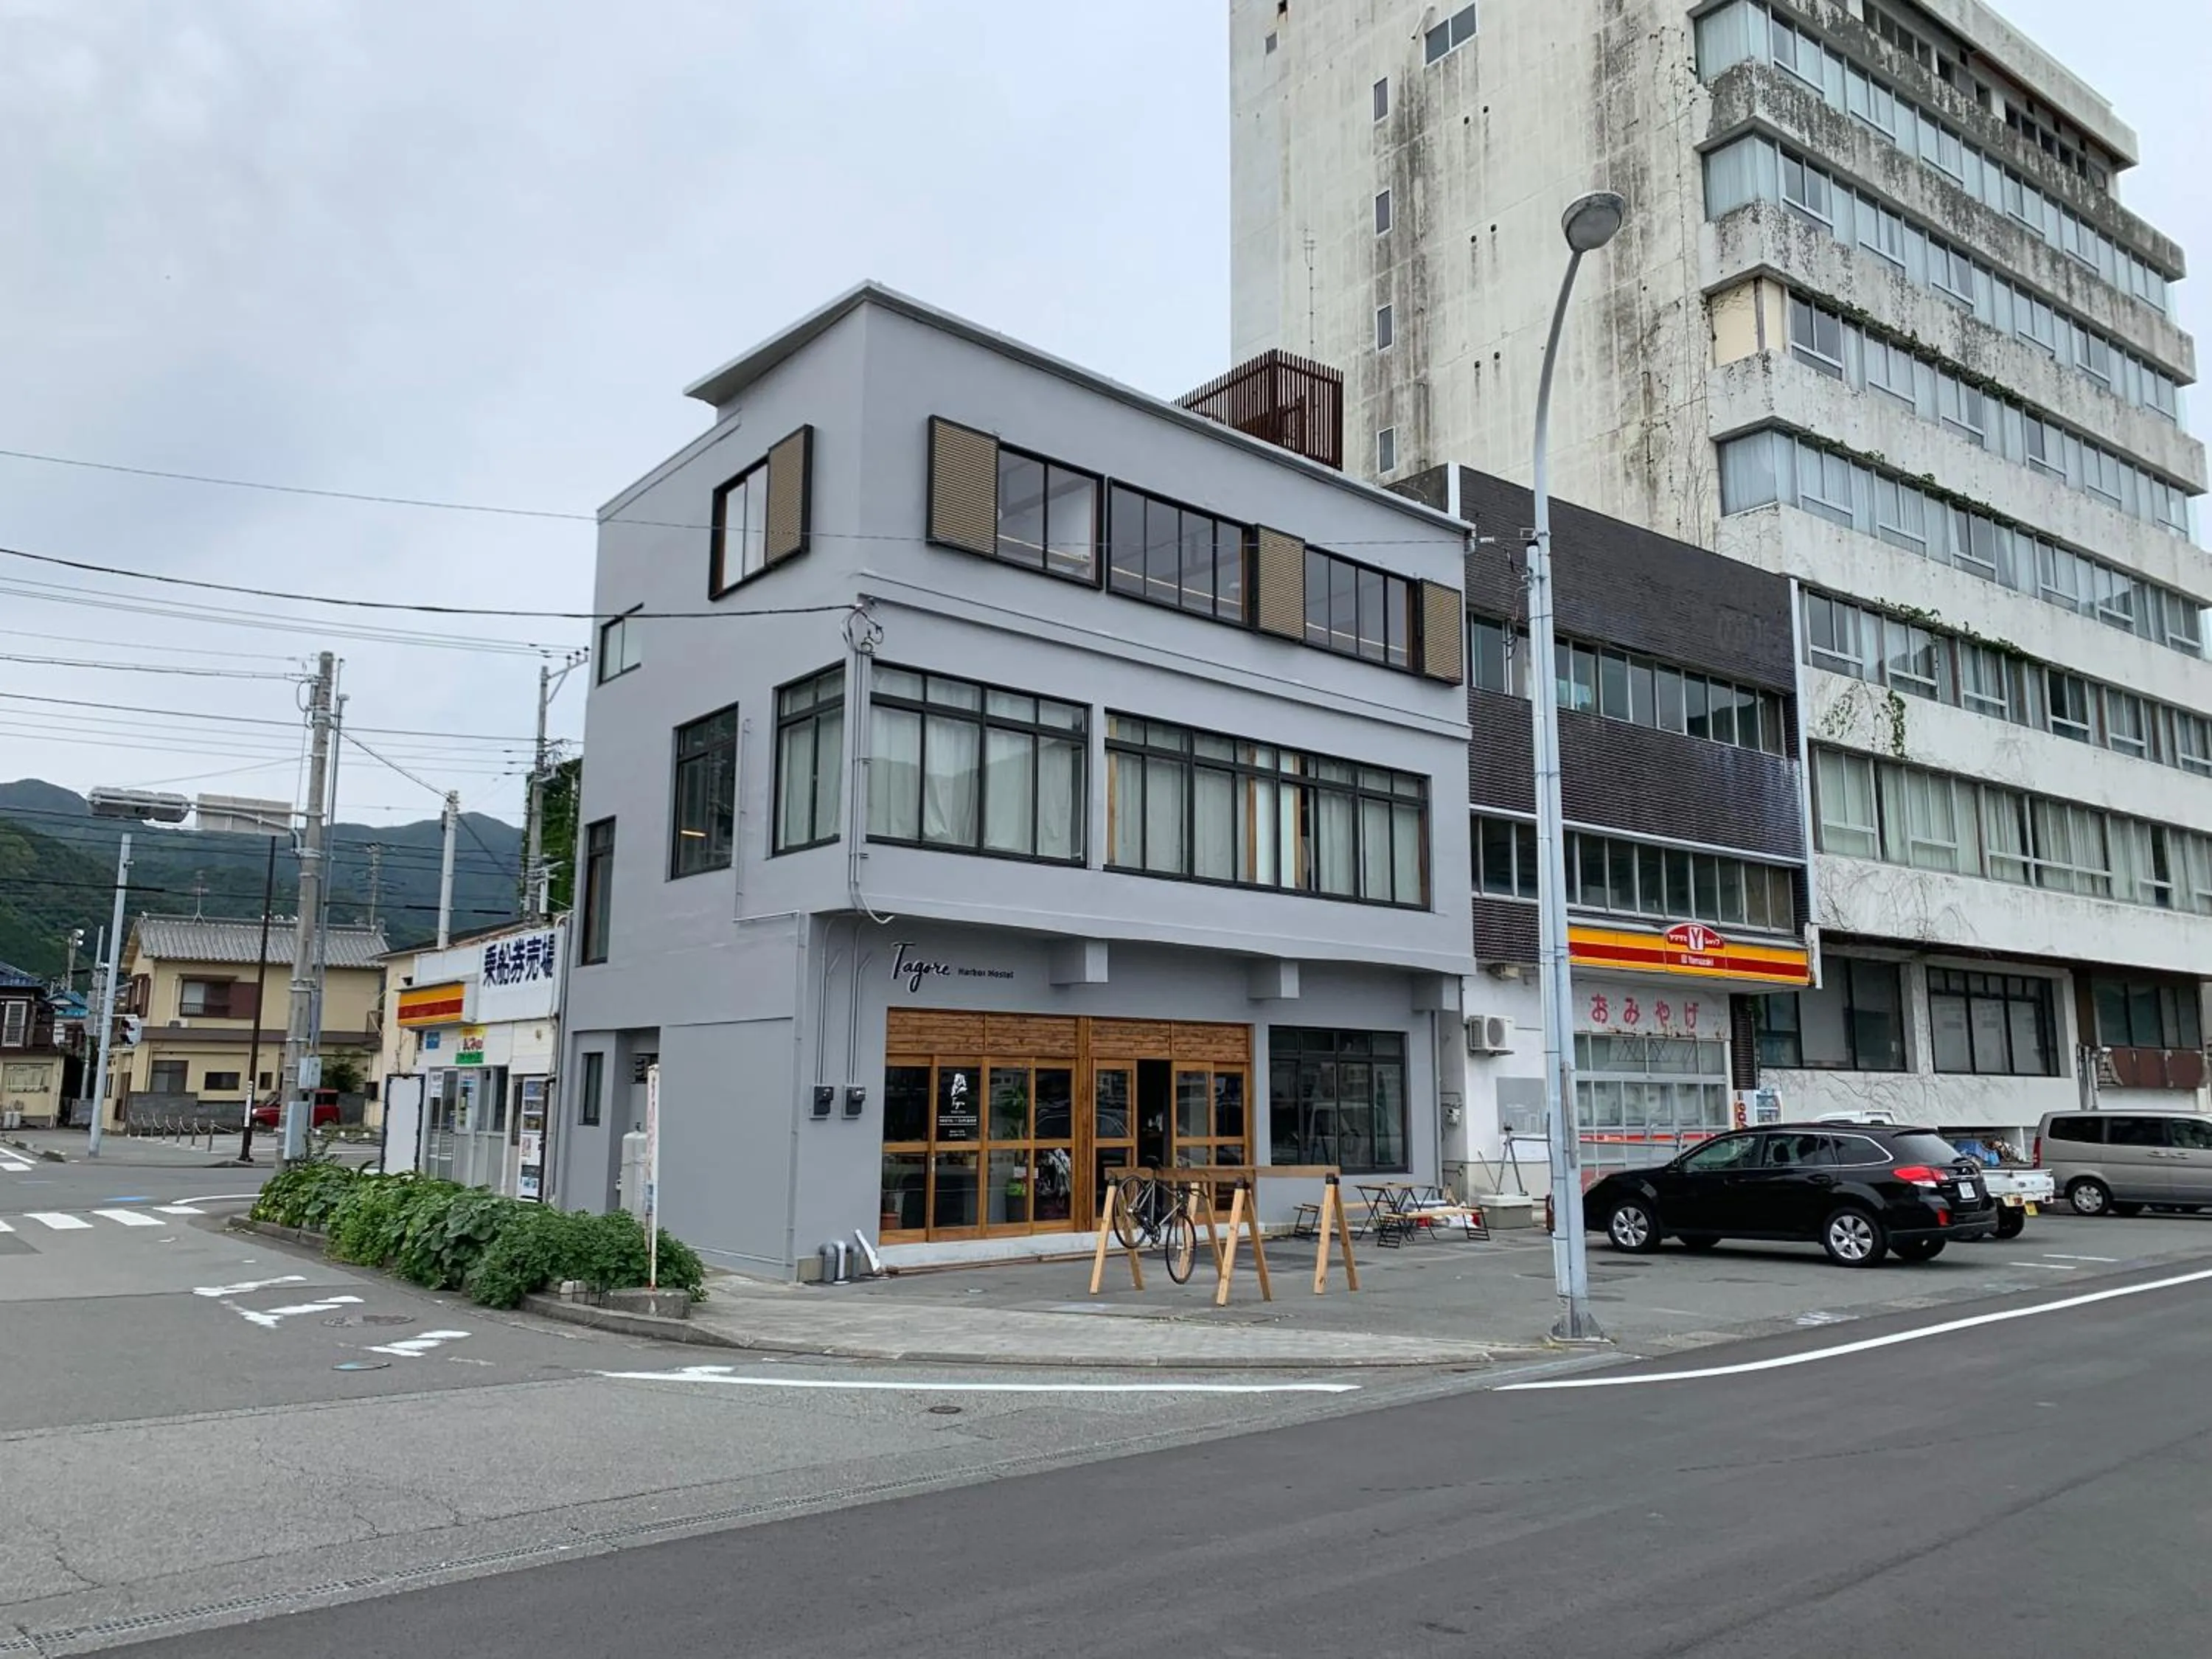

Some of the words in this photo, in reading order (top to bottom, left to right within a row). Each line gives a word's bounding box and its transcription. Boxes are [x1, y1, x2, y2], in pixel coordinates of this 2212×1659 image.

[484, 933, 554, 988] 乗船券売場
[891, 942, 950, 992] Tagore
[1591, 993, 1699, 1029] おみやげ
